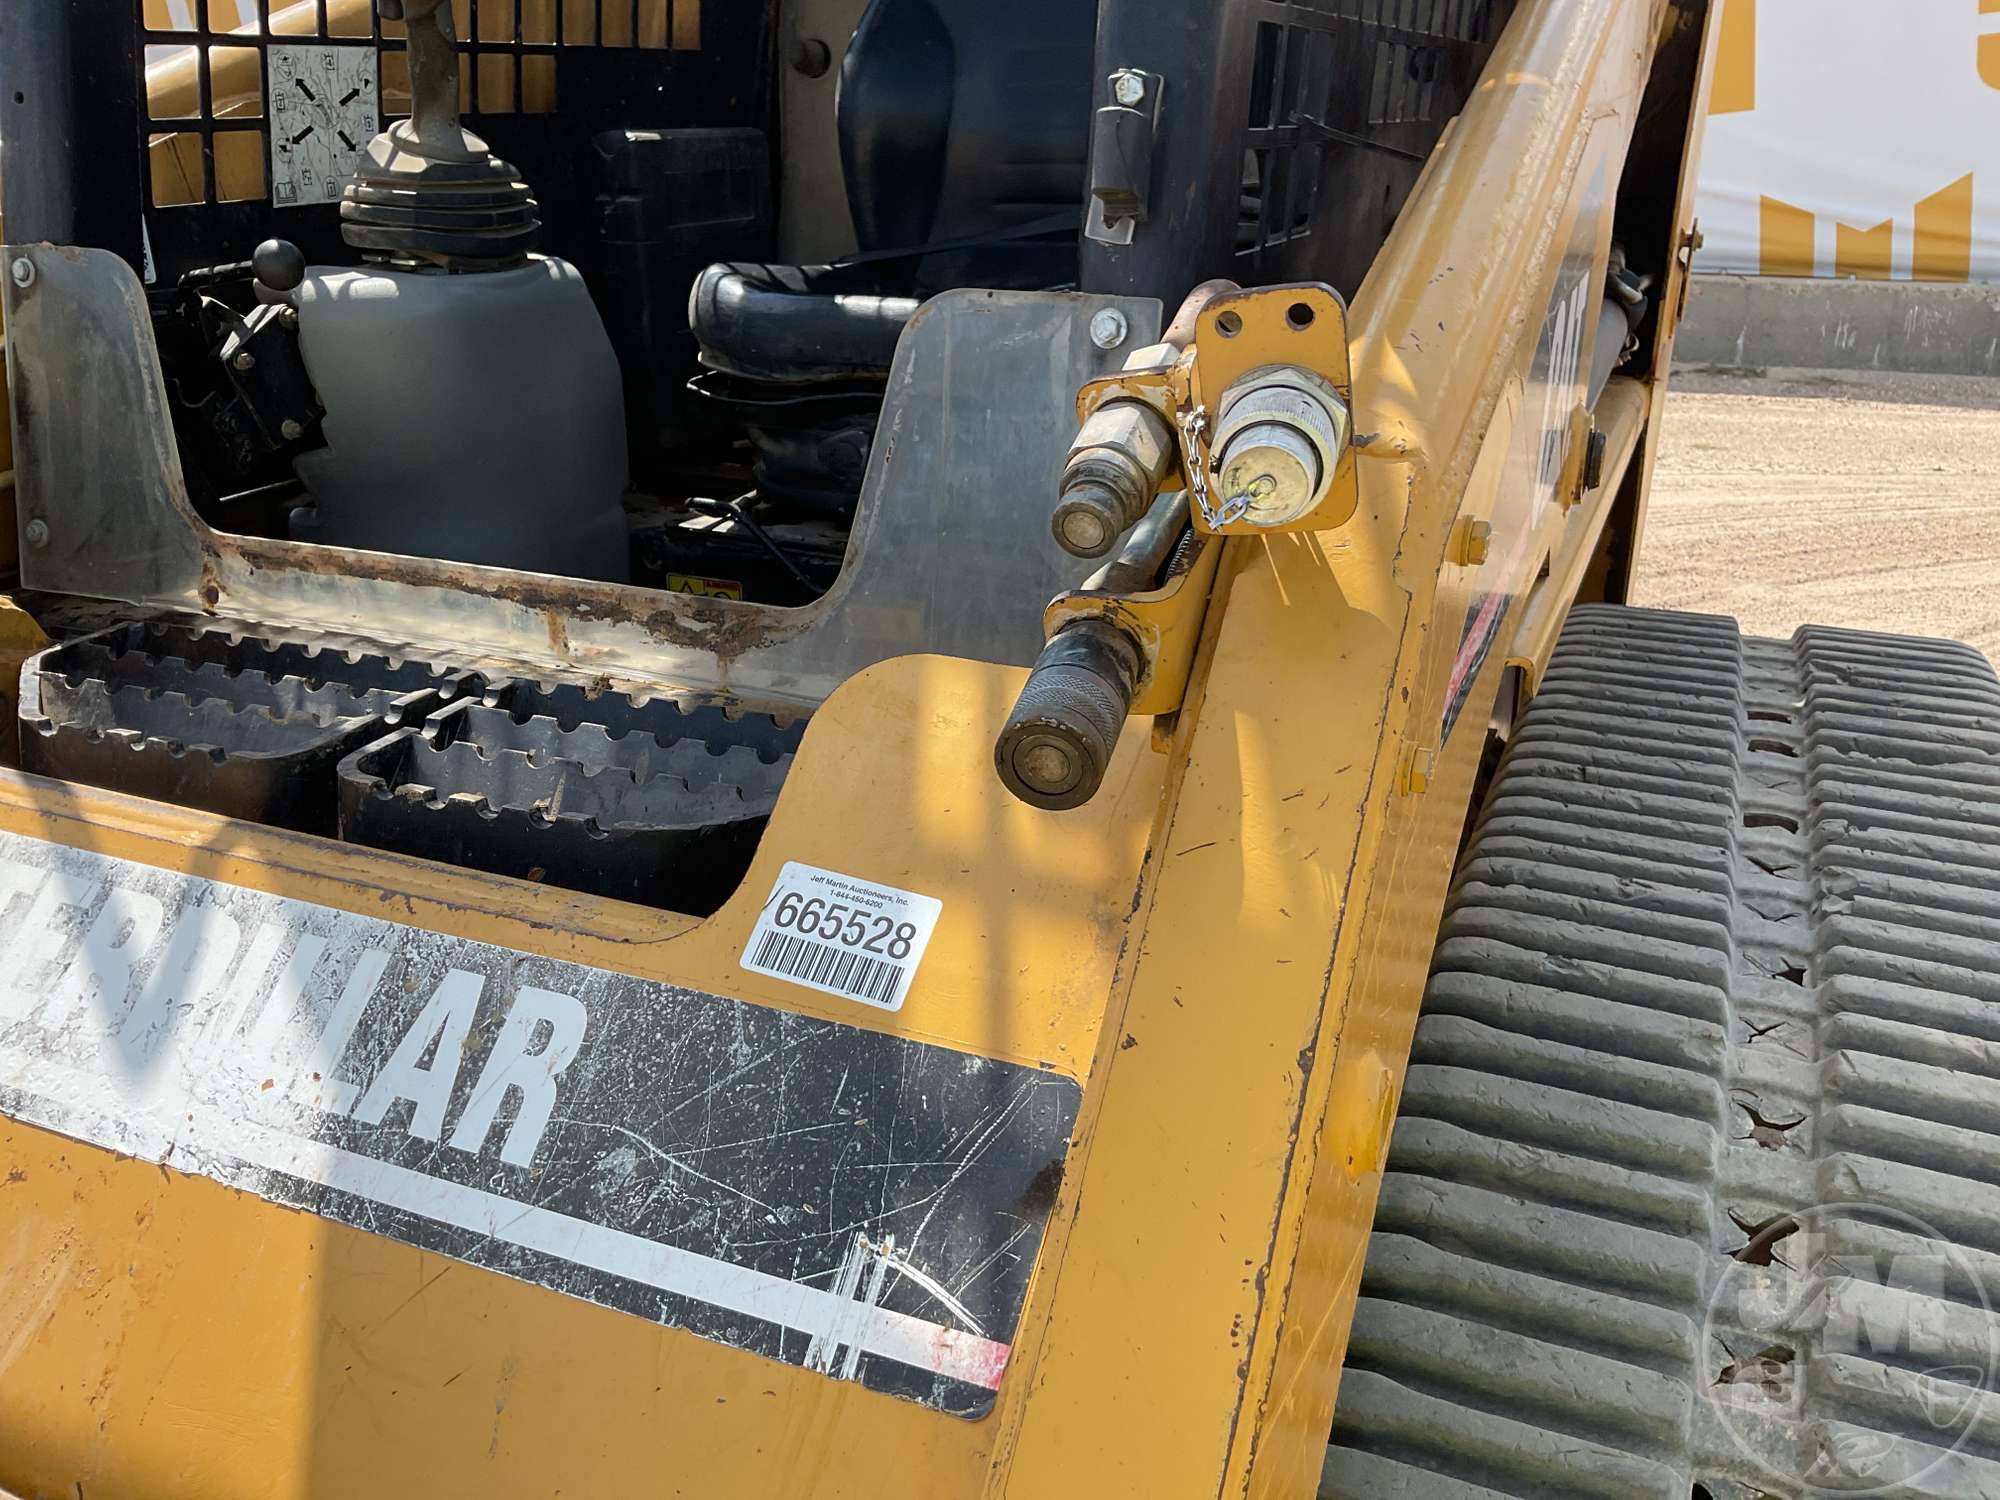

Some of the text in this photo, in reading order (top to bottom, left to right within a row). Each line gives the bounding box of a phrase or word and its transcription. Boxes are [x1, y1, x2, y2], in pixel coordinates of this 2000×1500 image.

[810, 874, 909, 906] Jeff Martin Auctioneers, Inc.
[774, 891, 917, 960] 665528
